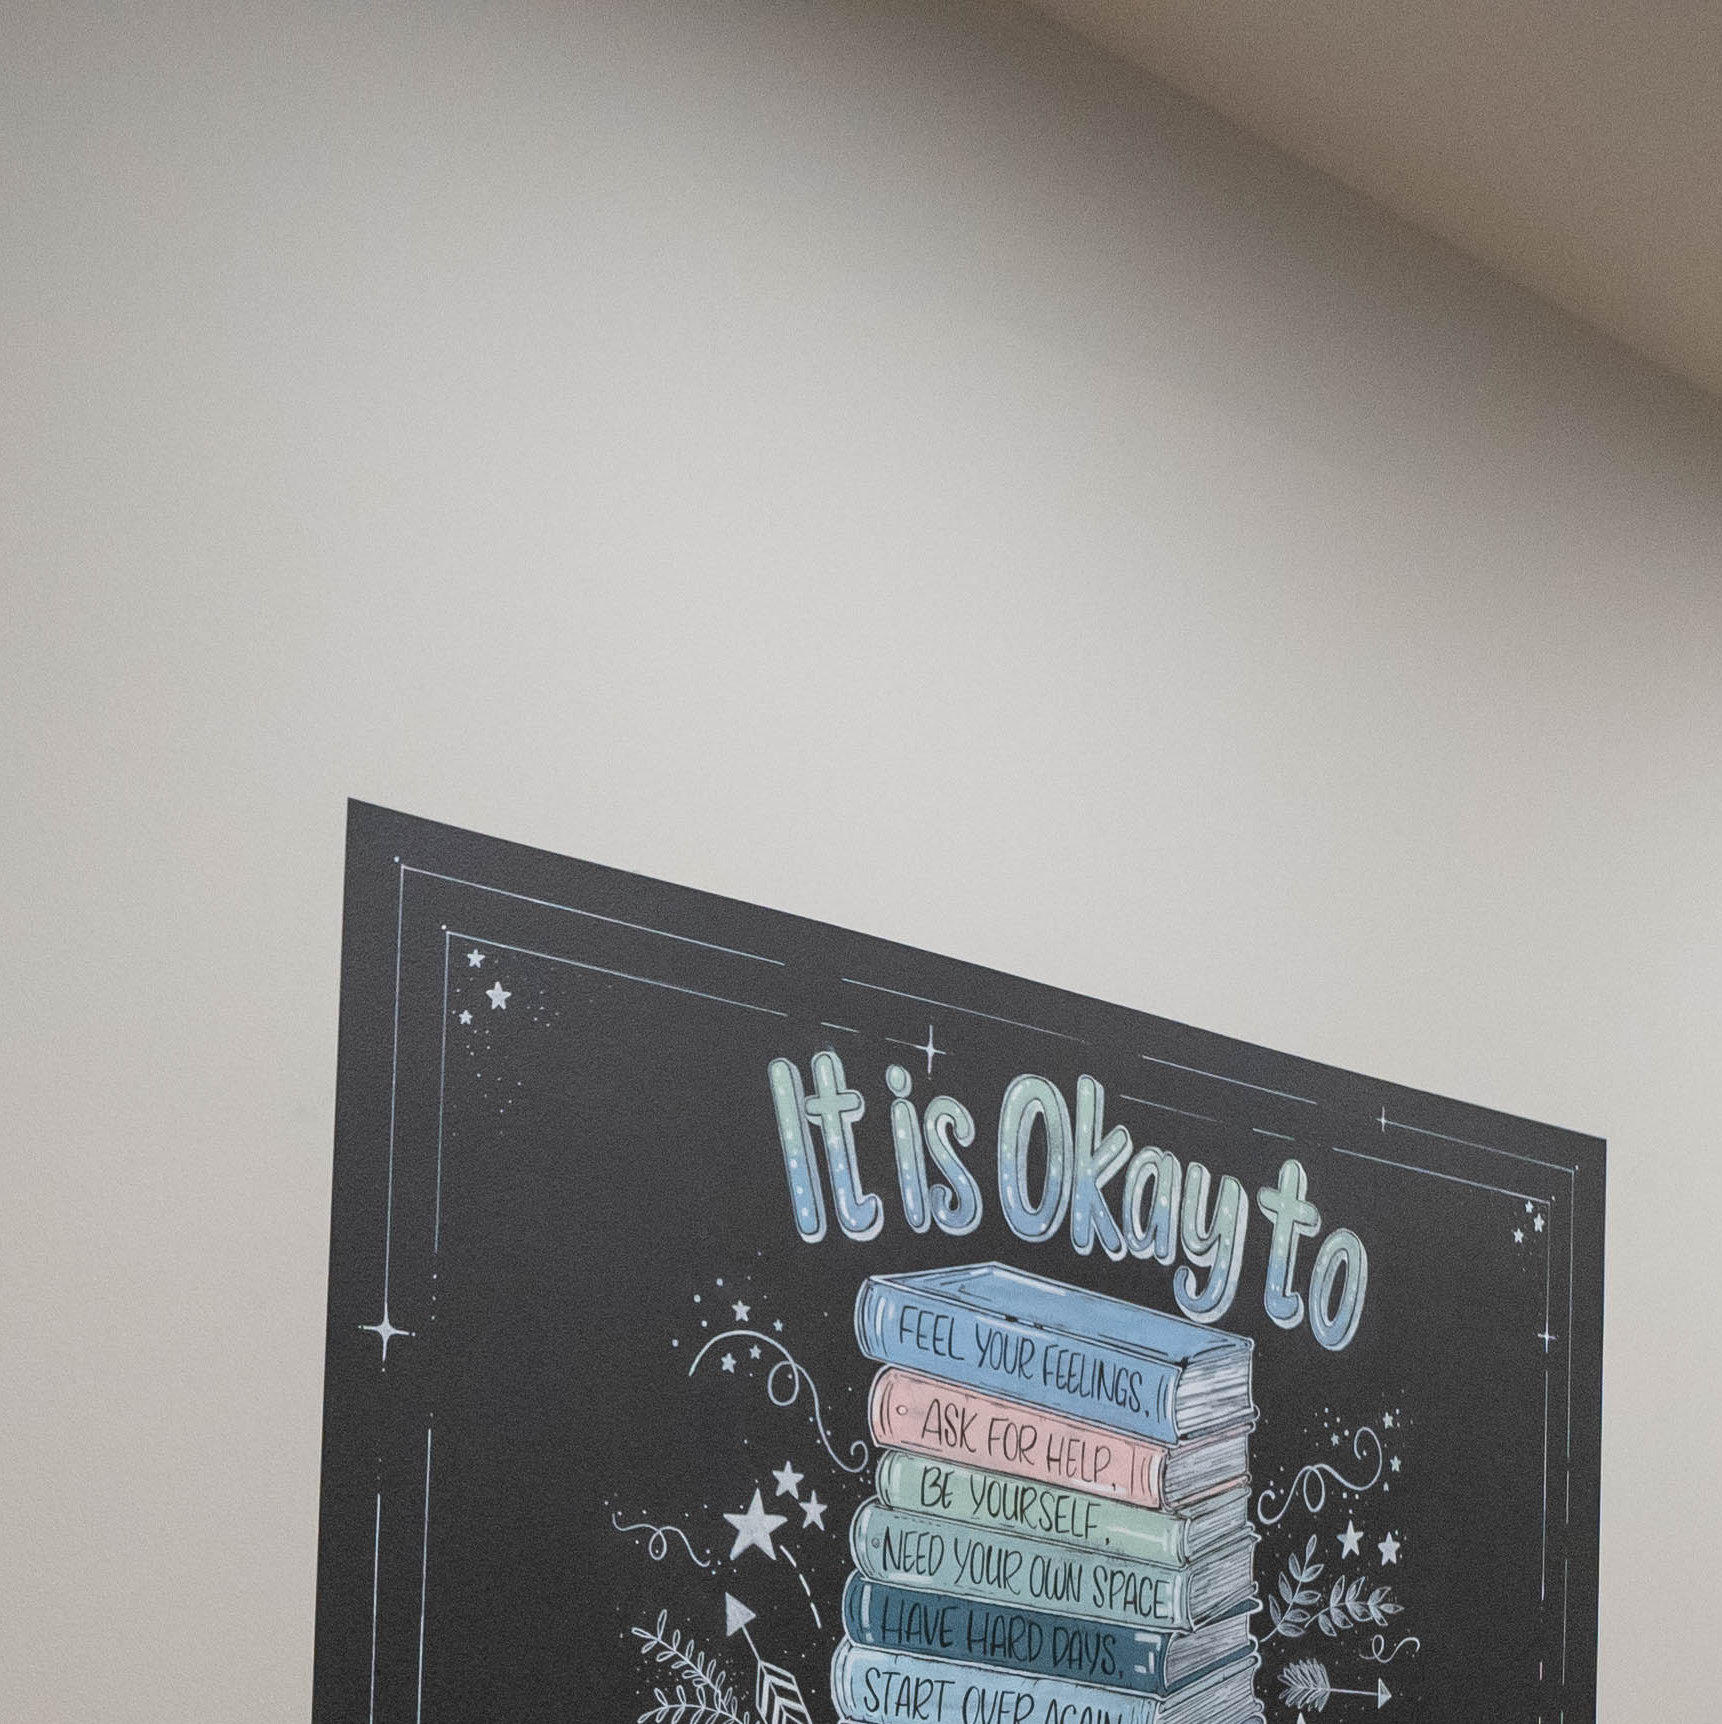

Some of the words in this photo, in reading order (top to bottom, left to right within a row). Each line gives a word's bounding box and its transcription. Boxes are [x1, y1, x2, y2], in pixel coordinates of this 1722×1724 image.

[768, 1050, 885, 1243] It
[885, 1064, 983, 1236] is
[996, 1073, 1250, 1324] Okay
[1256, 1158, 1369, 1352] to
[899, 1305, 965, 1361] FEEL
[976, 1322, 1036, 1380] YOUR
[920, 1398, 978, 1453] ASK
[988, 1417, 1037, 1465] FOR
[920, 1465, 955, 1508] BE
[882, 1526, 945, 1576] NEED
[953, 1538, 1023, 1596] YOUR
[1029, 1555, 1083, 1603] OWN
[881, 1596, 959, 1647] HAVE
[966, 1608, 1044, 1663] HARD
[863, 1667, 956, 1721] START
